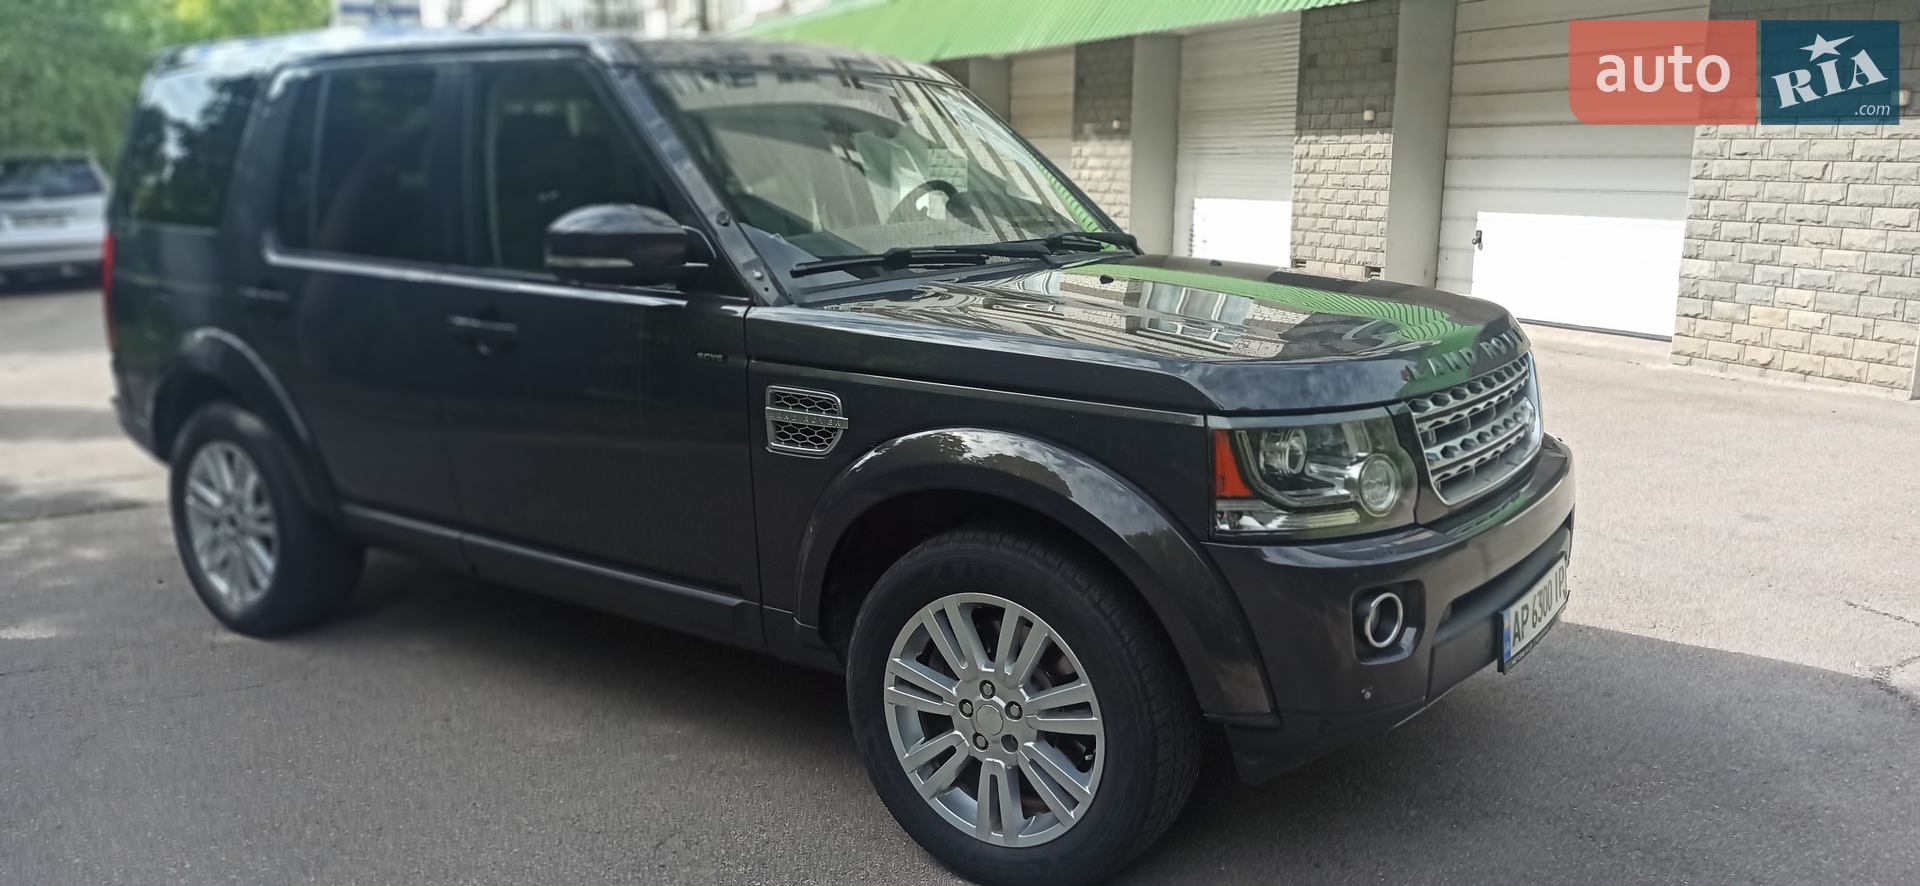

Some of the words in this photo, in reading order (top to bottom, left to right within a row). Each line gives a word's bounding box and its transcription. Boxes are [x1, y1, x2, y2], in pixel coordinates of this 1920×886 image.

[1405, 346, 1478, 381] LAND
[1512, 602, 1529, 647] AP
[1531, 578, 1553, 629] 6300
[1554, 565, 1565, 603] IP
